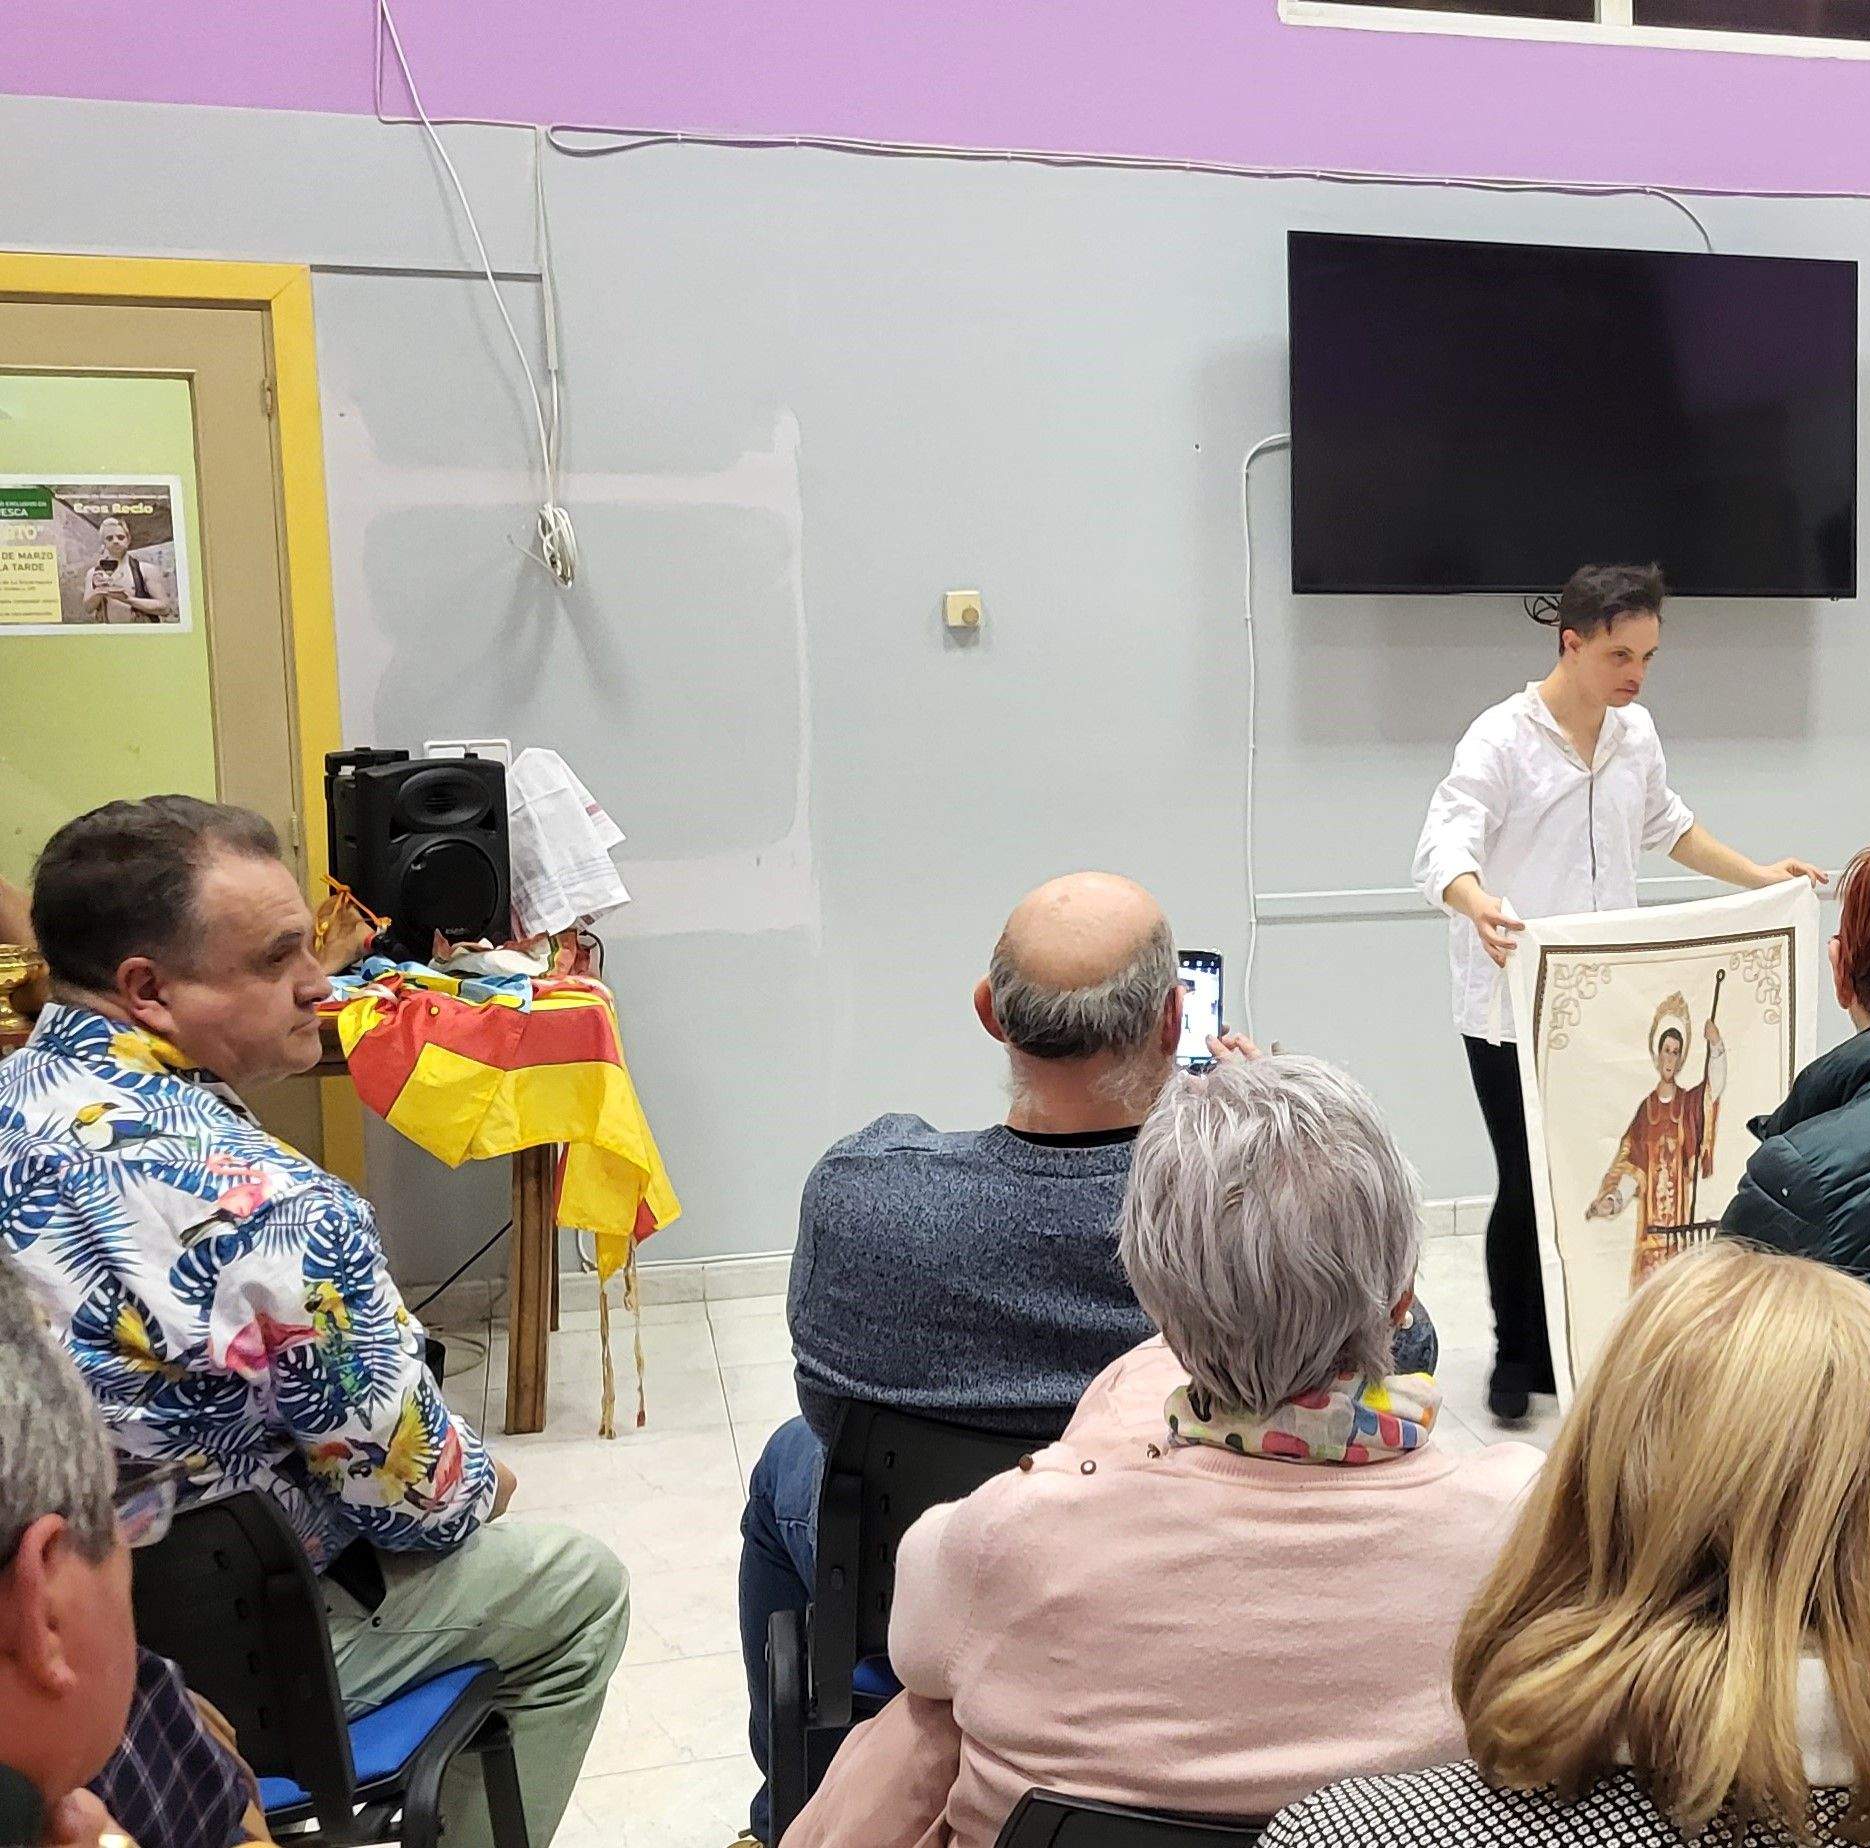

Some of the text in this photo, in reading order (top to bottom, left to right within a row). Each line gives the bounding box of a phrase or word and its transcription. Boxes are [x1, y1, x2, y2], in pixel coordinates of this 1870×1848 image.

[73, 502, 153, 514] Eros Recio
[2, 552, 54, 560] DE MARZO
[12, 563, 45, 571] TARDE
